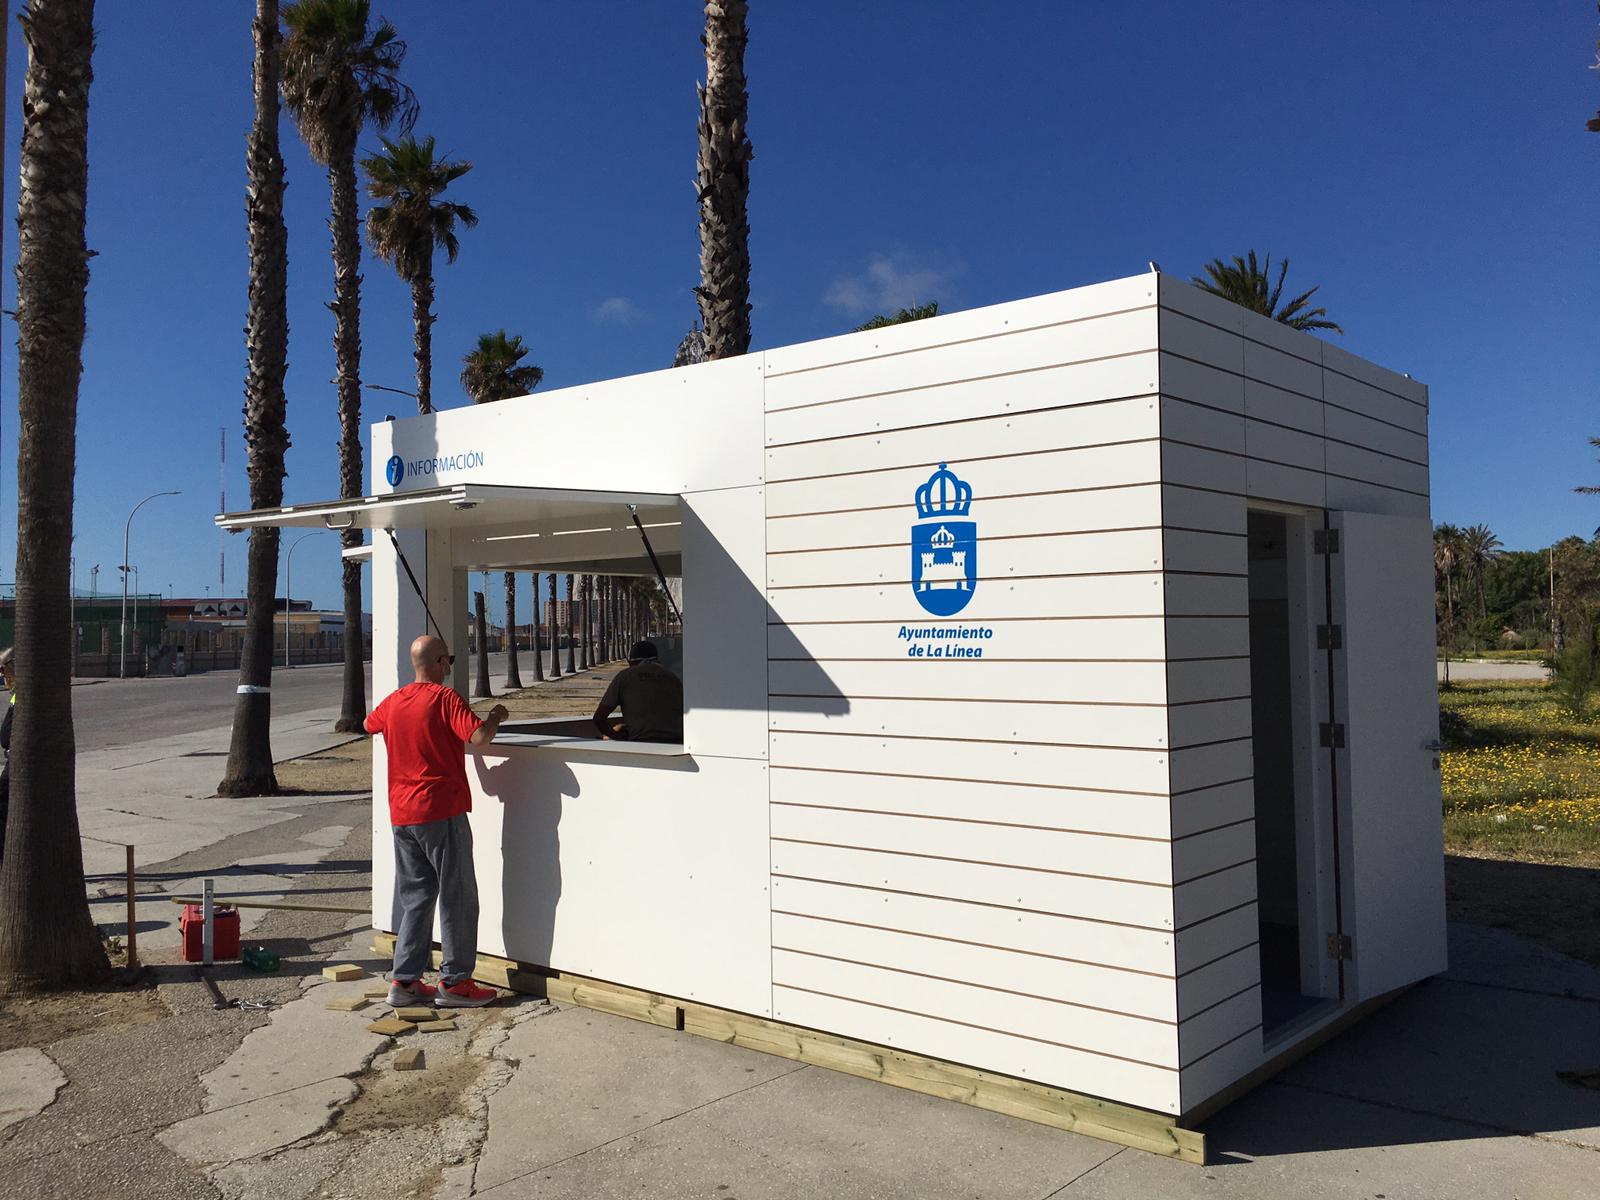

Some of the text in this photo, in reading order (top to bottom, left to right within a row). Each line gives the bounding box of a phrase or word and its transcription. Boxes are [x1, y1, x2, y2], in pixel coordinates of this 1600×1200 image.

[407, 449, 484, 477] INFORMACIÓN
[898, 624, 993, 642] Ayuntamiento
[908, 643, 983, 658] de La Línea
